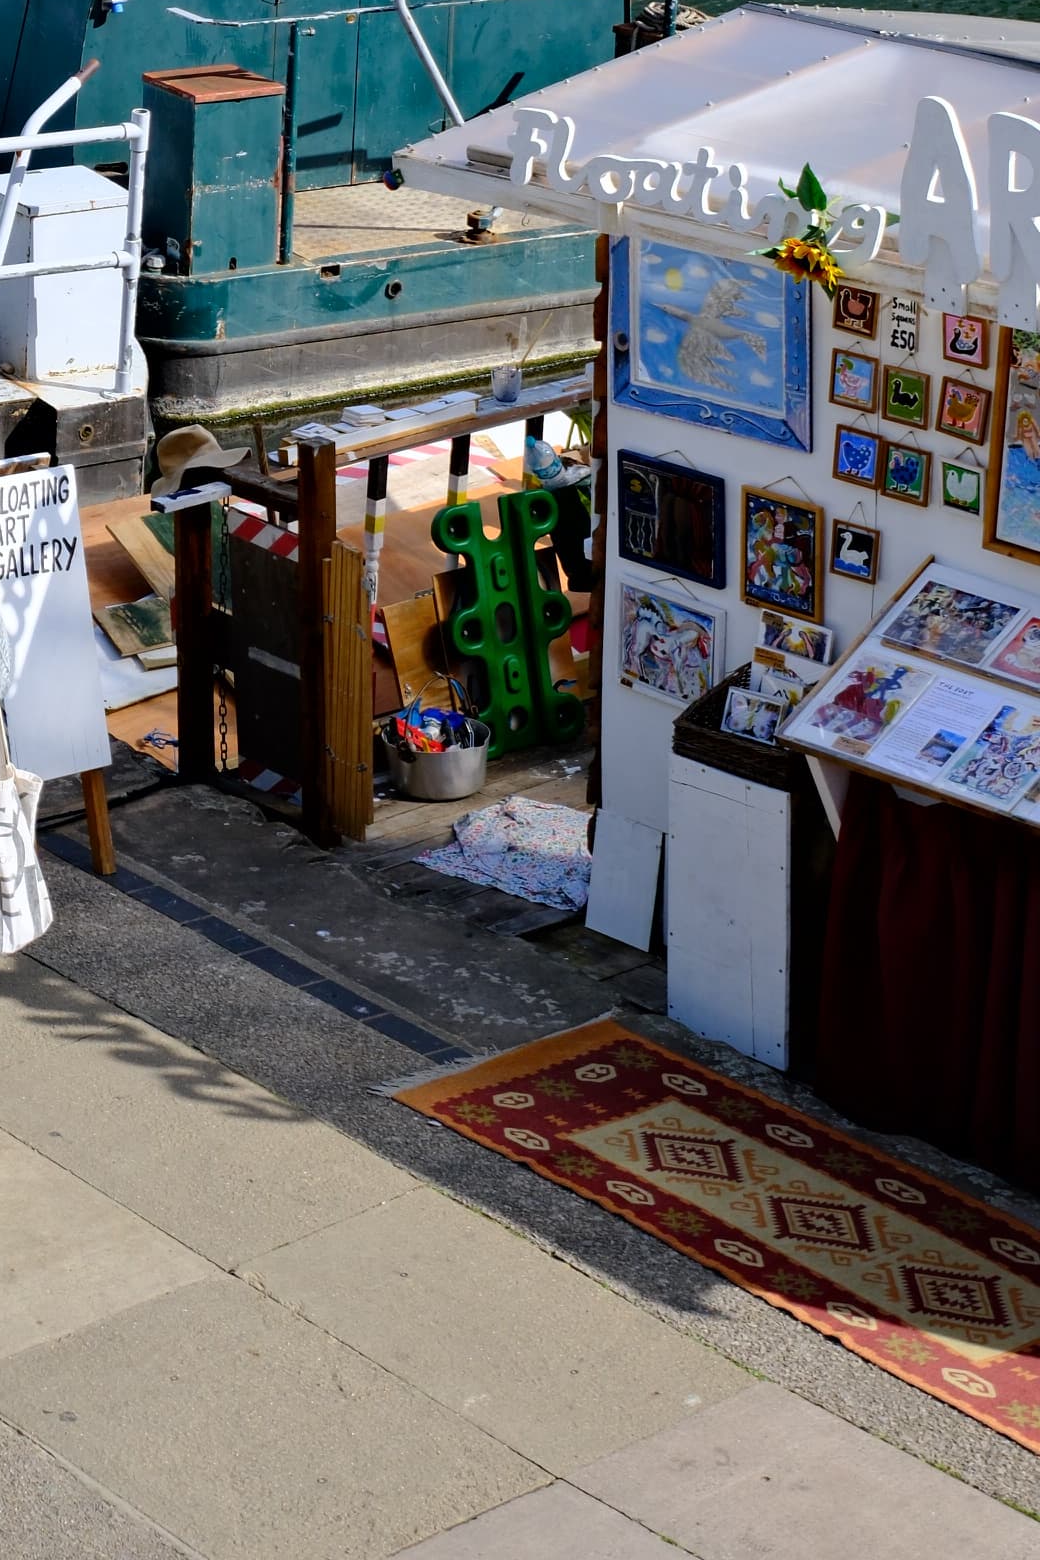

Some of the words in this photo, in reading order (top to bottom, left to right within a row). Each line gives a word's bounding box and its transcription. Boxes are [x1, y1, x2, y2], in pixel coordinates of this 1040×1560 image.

[507, 107, 888, 263] Floating
[892, 296, 916, 315] Small
[890, 328, 915, 352] £50
